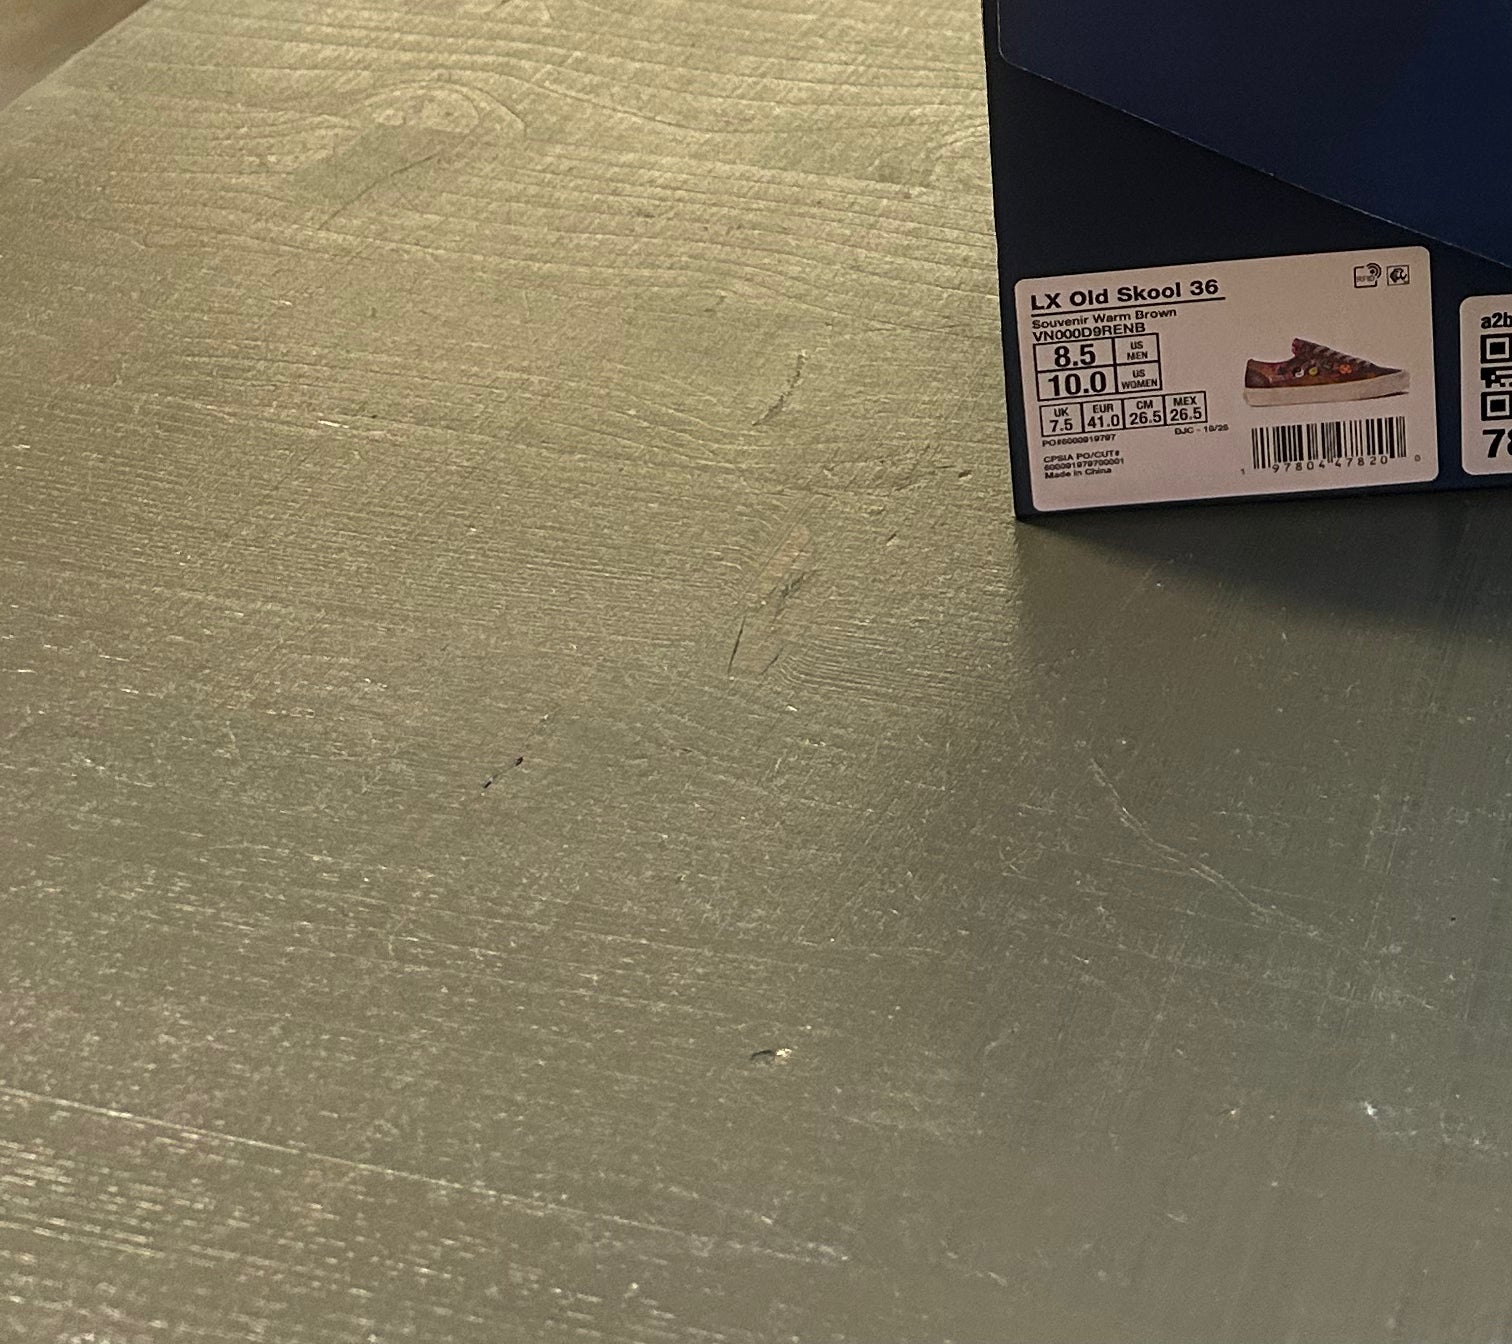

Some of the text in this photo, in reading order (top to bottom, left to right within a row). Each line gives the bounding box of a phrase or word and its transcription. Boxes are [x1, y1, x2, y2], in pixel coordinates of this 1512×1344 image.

[1031, 279, 1219, 310] LX Old Skool 36
[1032, 309, 1177, 330] Souvenir Warm Brown
[1033, 322, 1146, 342] VN000D9RENB
[1130, 341, 1144, 350] US
[1054, 343, 1096, 368] 8.5
[1127, 351, 1148, 361] MEN
[1132, 369, 1146, 378] US
[1048, 370, 1107, 397] 10.0
[1121, 378, 1158, 390] WOMEN
[1136, 400, 1153, 410] CM
[1173, 396, 1197, 406] MEX
[1054, 407, 1069, 417] UK
[1093, 404, 1114, 414] EUR
[1170, 407, 1202, 422] 26.5
[1087, 414, 1120, 429] 41.0
[1129, 411, 1162, 426] 26.5
[1050, 418, 1073, 433] 7.5
[1043, 454, 1074, 463] CPSIA
[1045, 471, 1072, 479] Made
[1085, 466, 1112, 475] China
